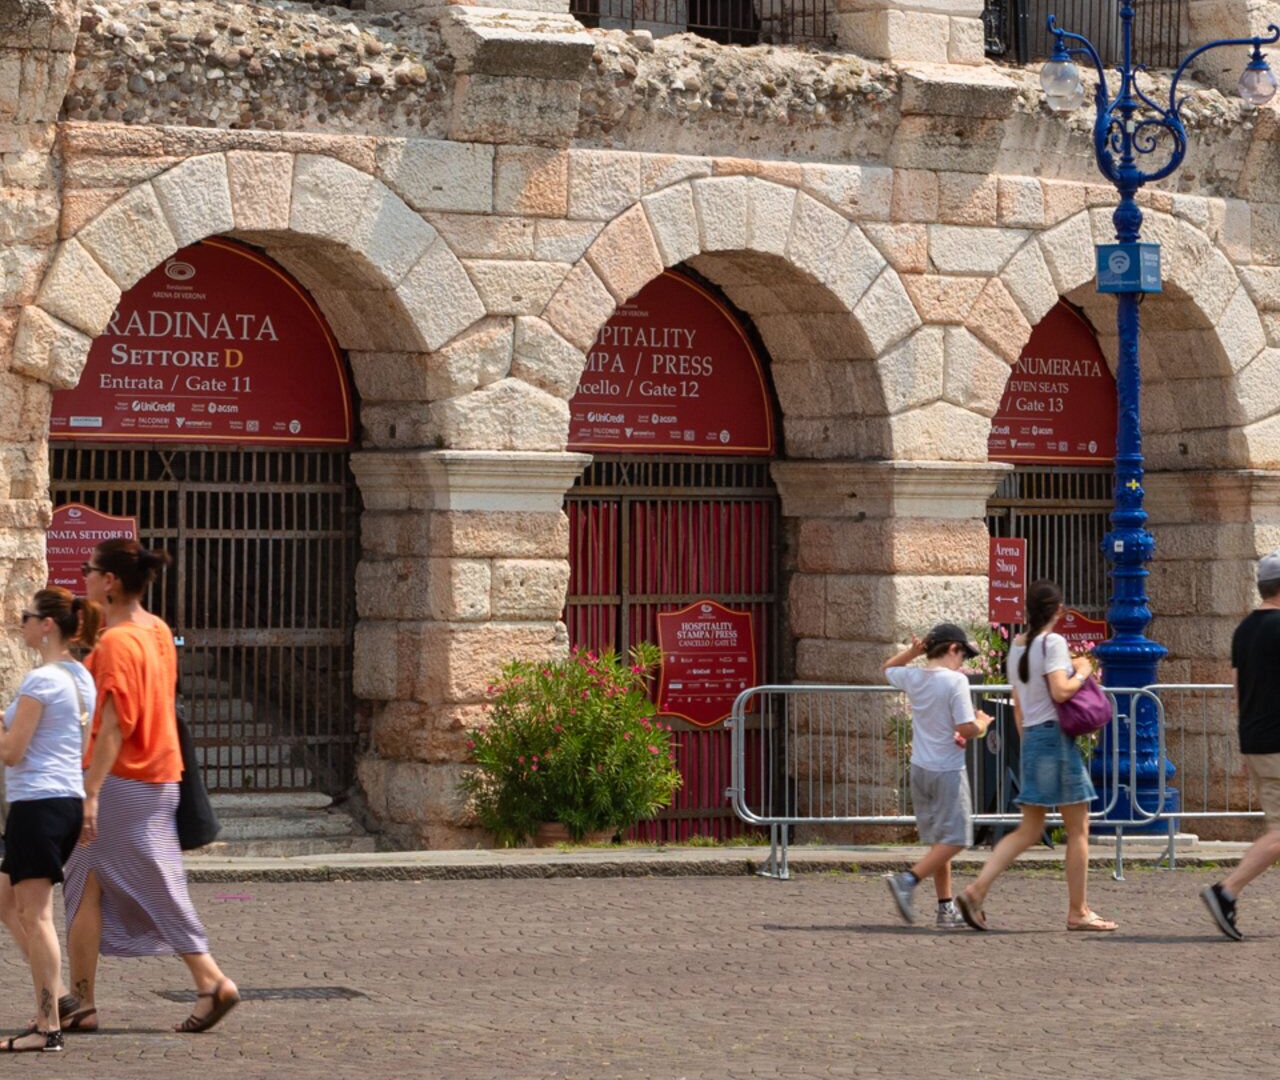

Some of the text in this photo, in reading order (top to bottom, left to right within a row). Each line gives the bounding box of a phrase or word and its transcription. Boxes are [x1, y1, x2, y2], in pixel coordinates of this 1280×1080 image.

[600, 326, 696, 349] PITALITY
[224, 349, 243, 368] D
[634, 352, 642, 376] /
[651, 354, 713, 377] PRESS
[1016, 358, 1102, 377] NUMERATA
[100, 373, 252, 392] Entrata / Gate 11
[626, 379, 634, 398] /
[639, 381, 677, 397] Gate
[679, 381, 699, 398] 12
[1010, 381, 1037, 392] EVEN
[1039, 382, 1069, 393] SEATS
[140, 402, 175, 413] UniCredit
[1006, 397, 1064, 412] / Gate 13
[595, 413, 625, 423] UniCredit
[125, 531, 133, 539] D
[995, 543, 1020, 557] Arena
[996, 558, 1017, 576] Shop
[991, 580, 1009, 588] Official
[681, 622, 732, 631] HOSPITALITY
[677, 631, 709, 639] STAMPA
[1071, 632, 1105, 640] NUMERATA
